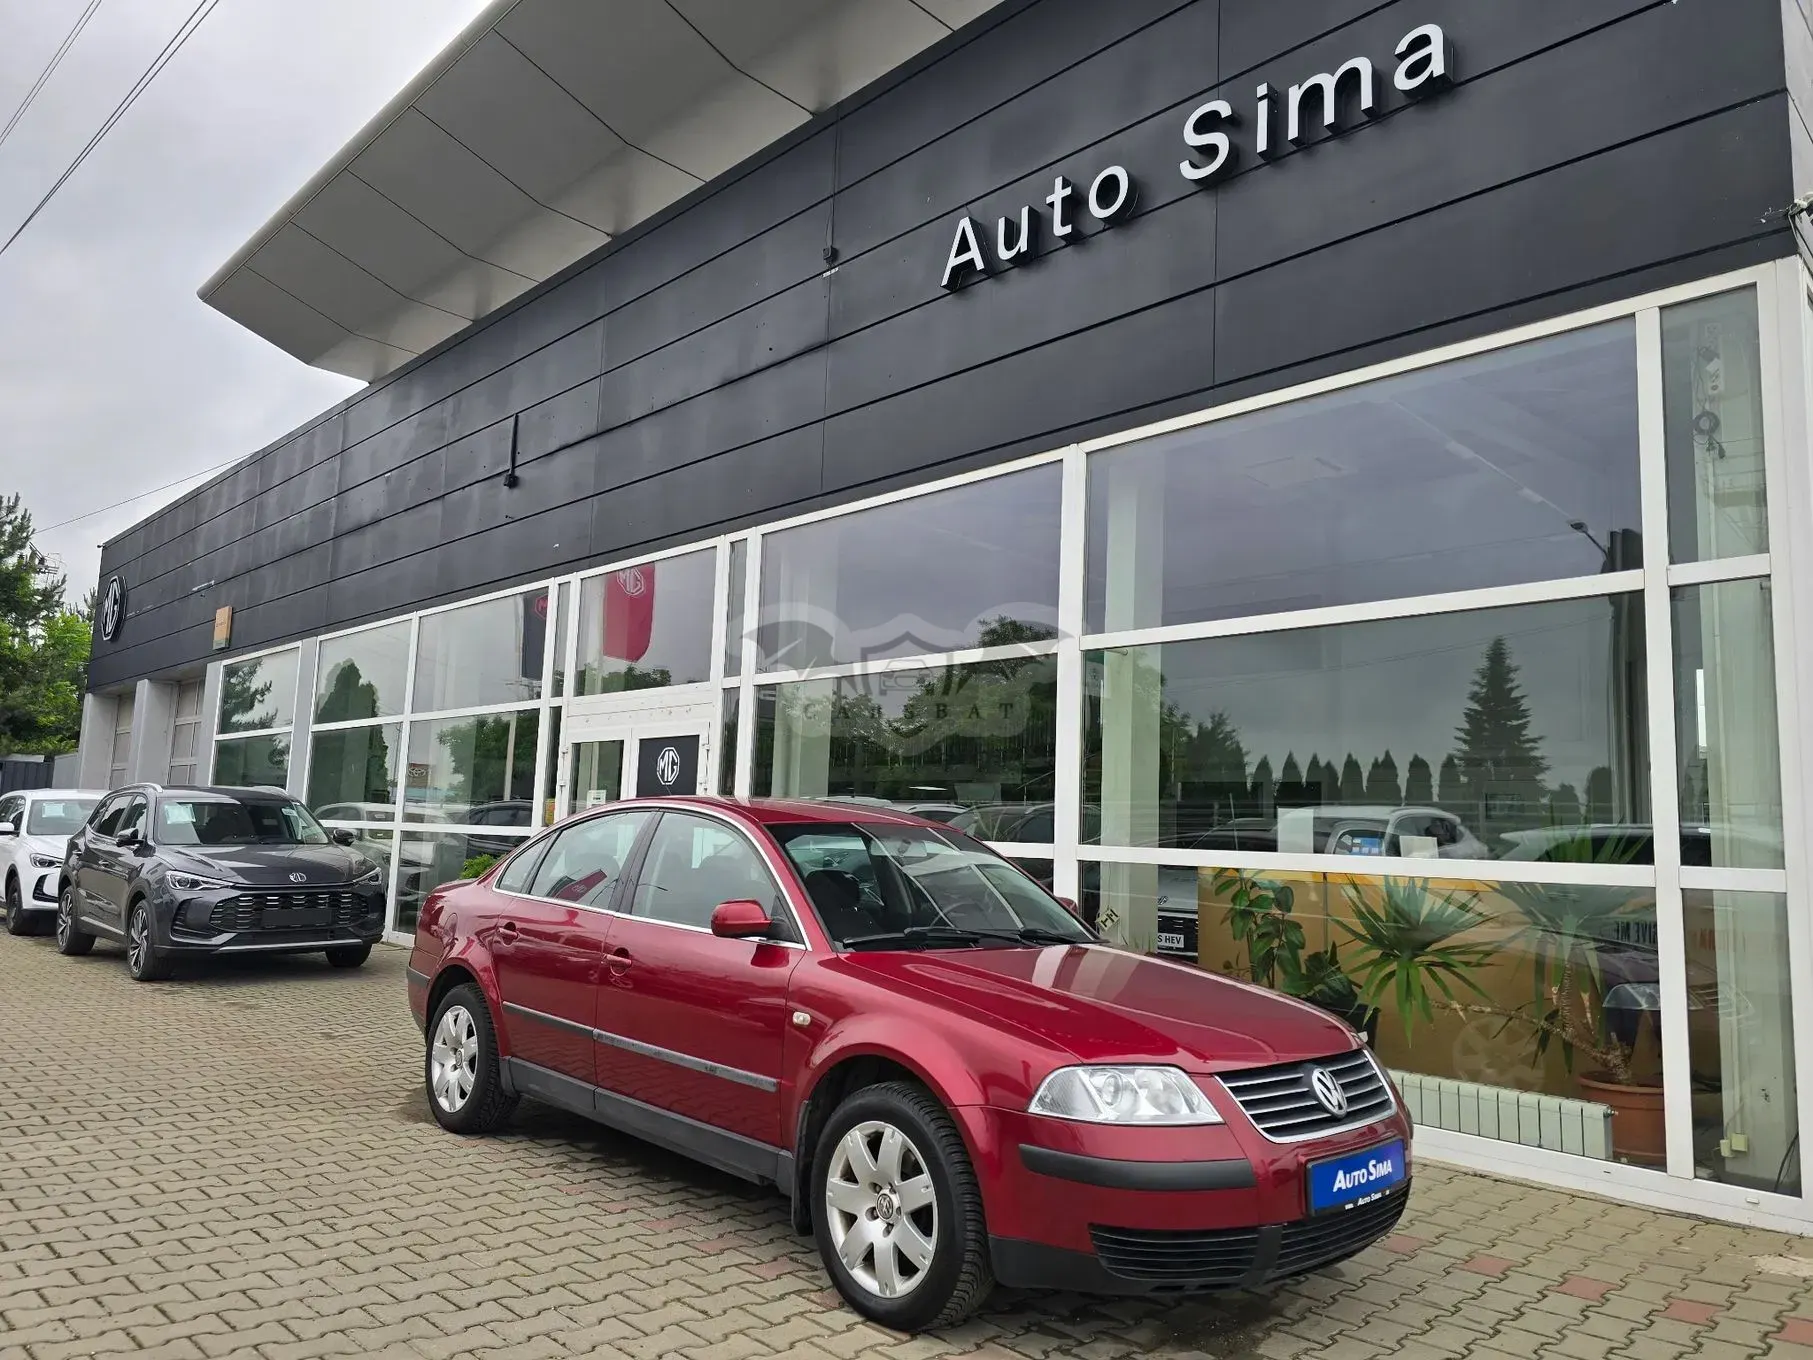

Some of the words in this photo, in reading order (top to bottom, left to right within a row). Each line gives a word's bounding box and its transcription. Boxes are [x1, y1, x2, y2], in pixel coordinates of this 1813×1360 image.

[940, 165, 1133, 288] Auto
[1180, 23, 1449, 181] Sima
[102, 577, 122, 639] MG
[658, 750, 679, 783] MG
[1165, 935, 1182, 944] HEV
[1313, 1070, 1345, 1113] VW
